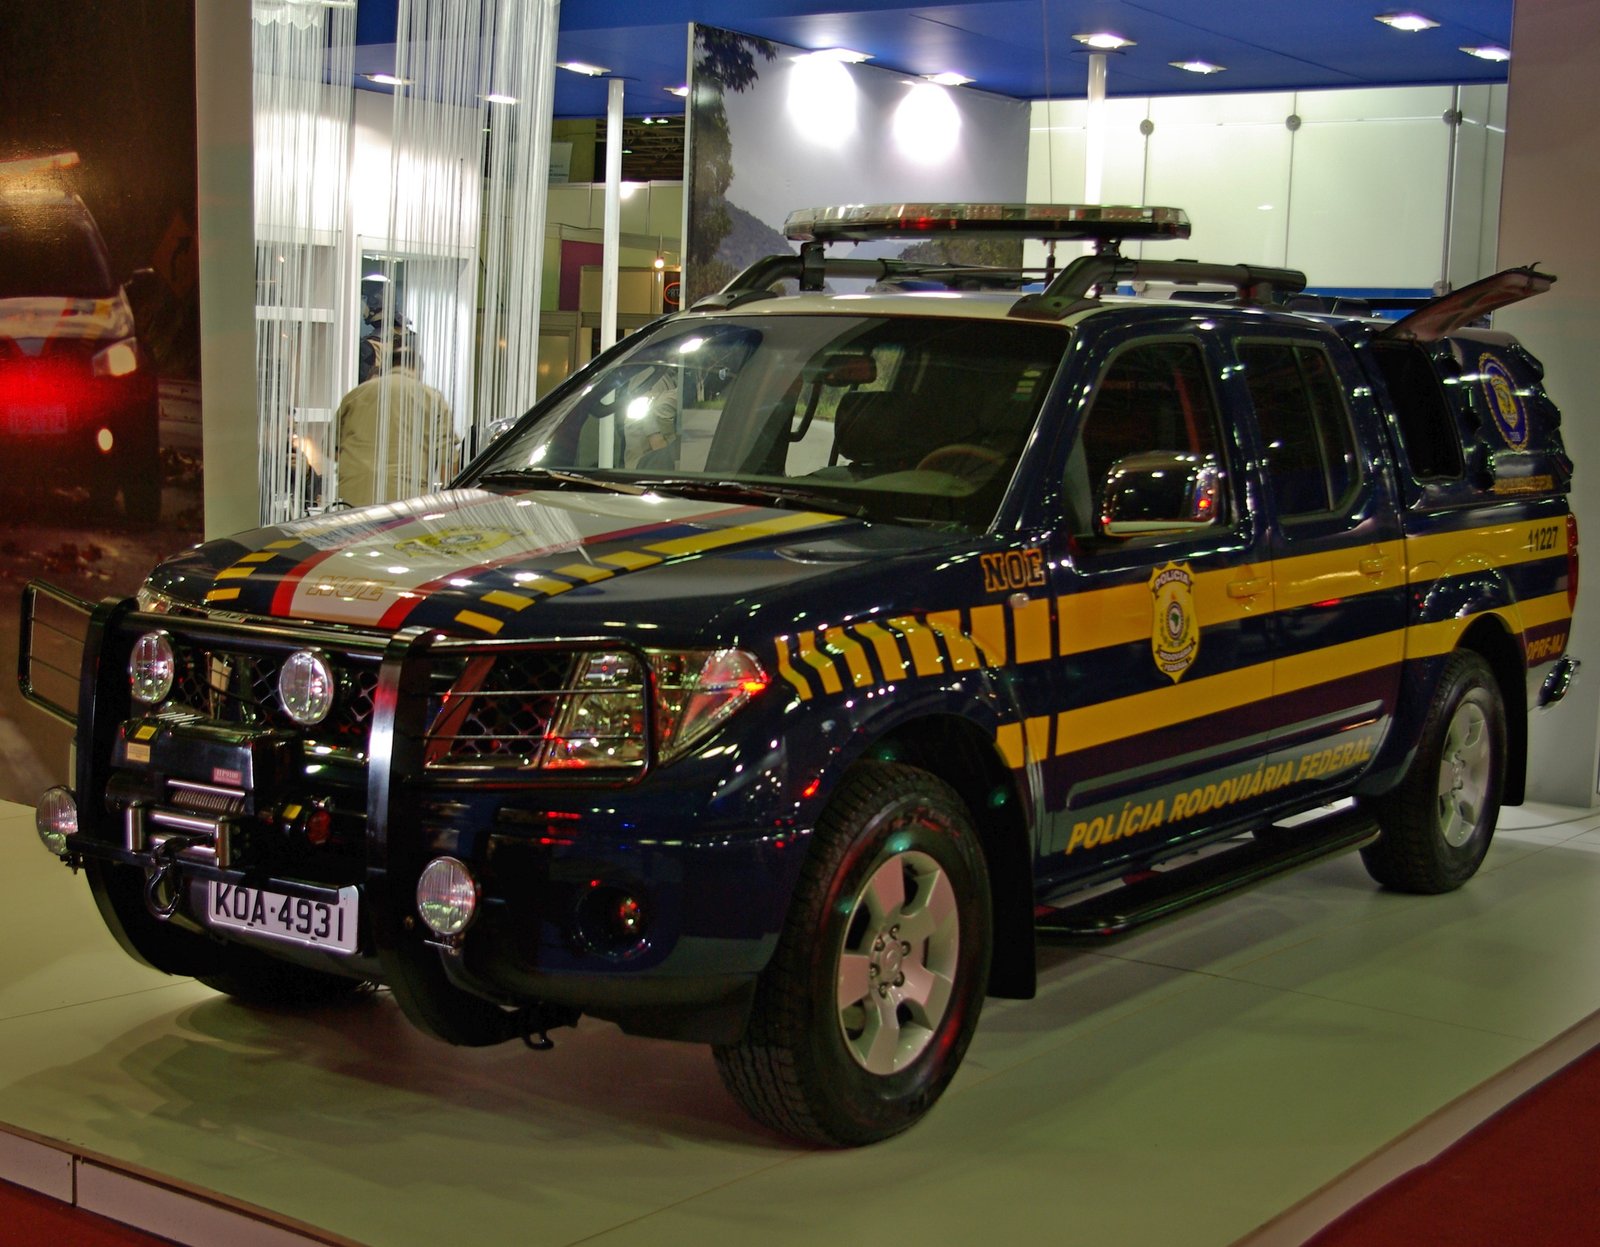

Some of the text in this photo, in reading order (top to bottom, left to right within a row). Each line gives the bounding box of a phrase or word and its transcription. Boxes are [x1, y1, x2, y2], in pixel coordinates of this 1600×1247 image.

[1528, 526, 1558, 552] 11227
[980, 548, 1046, 592] NOE
[1065, 736, 1375, 855] POLÍCIA RODOVIÁRIA FEDERAL
